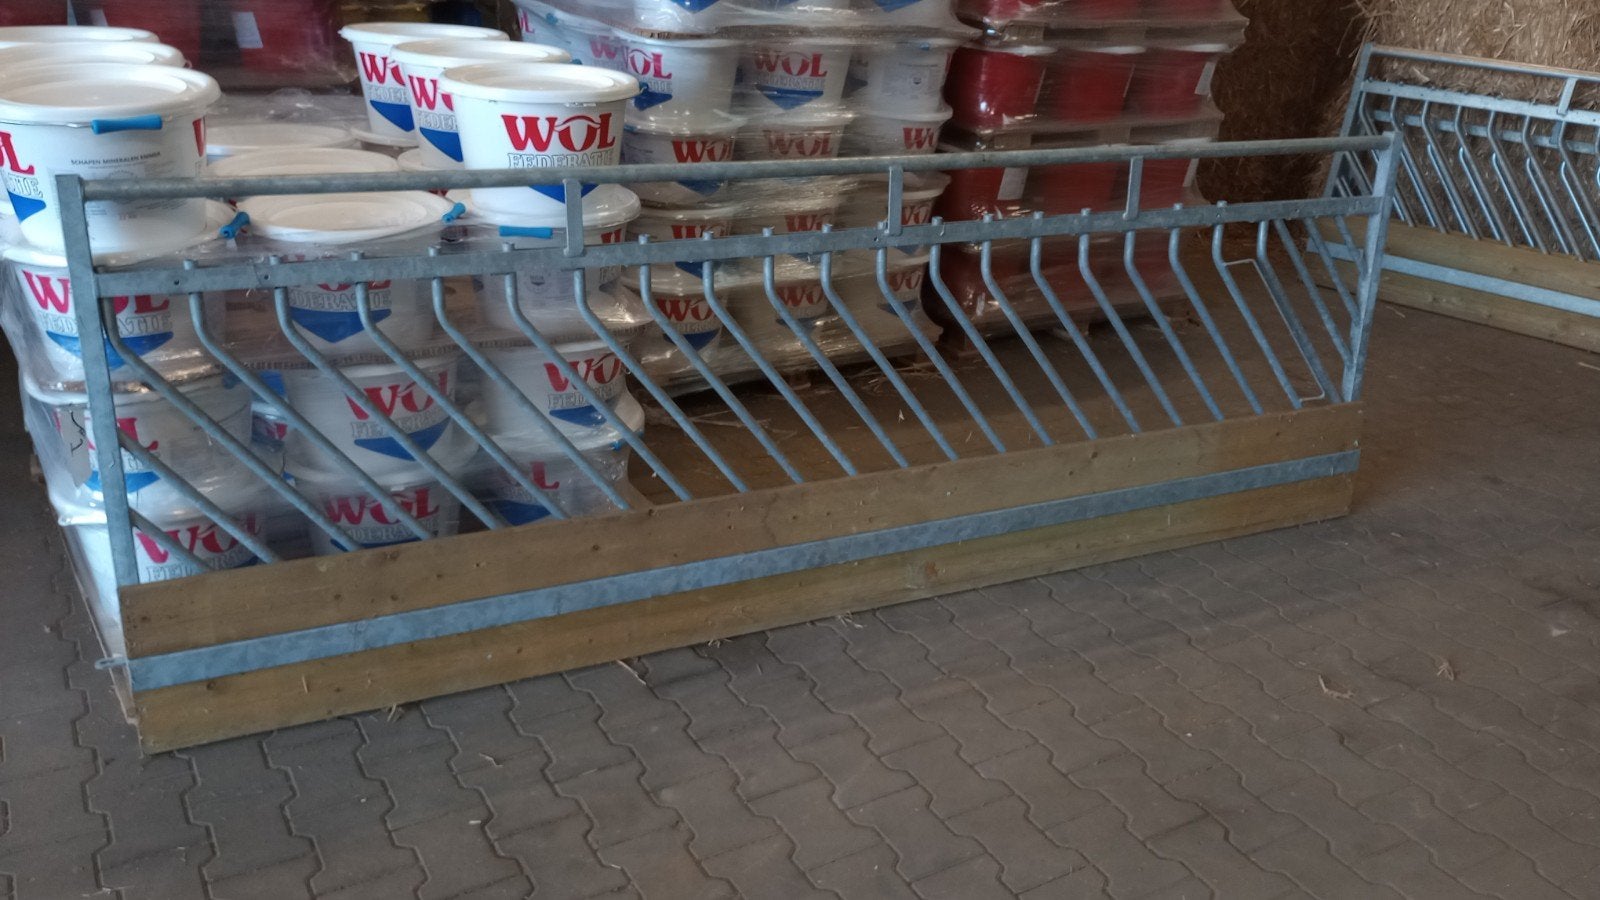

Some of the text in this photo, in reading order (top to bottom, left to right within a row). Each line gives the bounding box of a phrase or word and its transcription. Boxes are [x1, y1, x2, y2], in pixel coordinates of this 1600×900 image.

[755, 51, 828, 77] WOL
[501, 112, 616, 152] WOL
[763, 130, 833, 157] WOL
